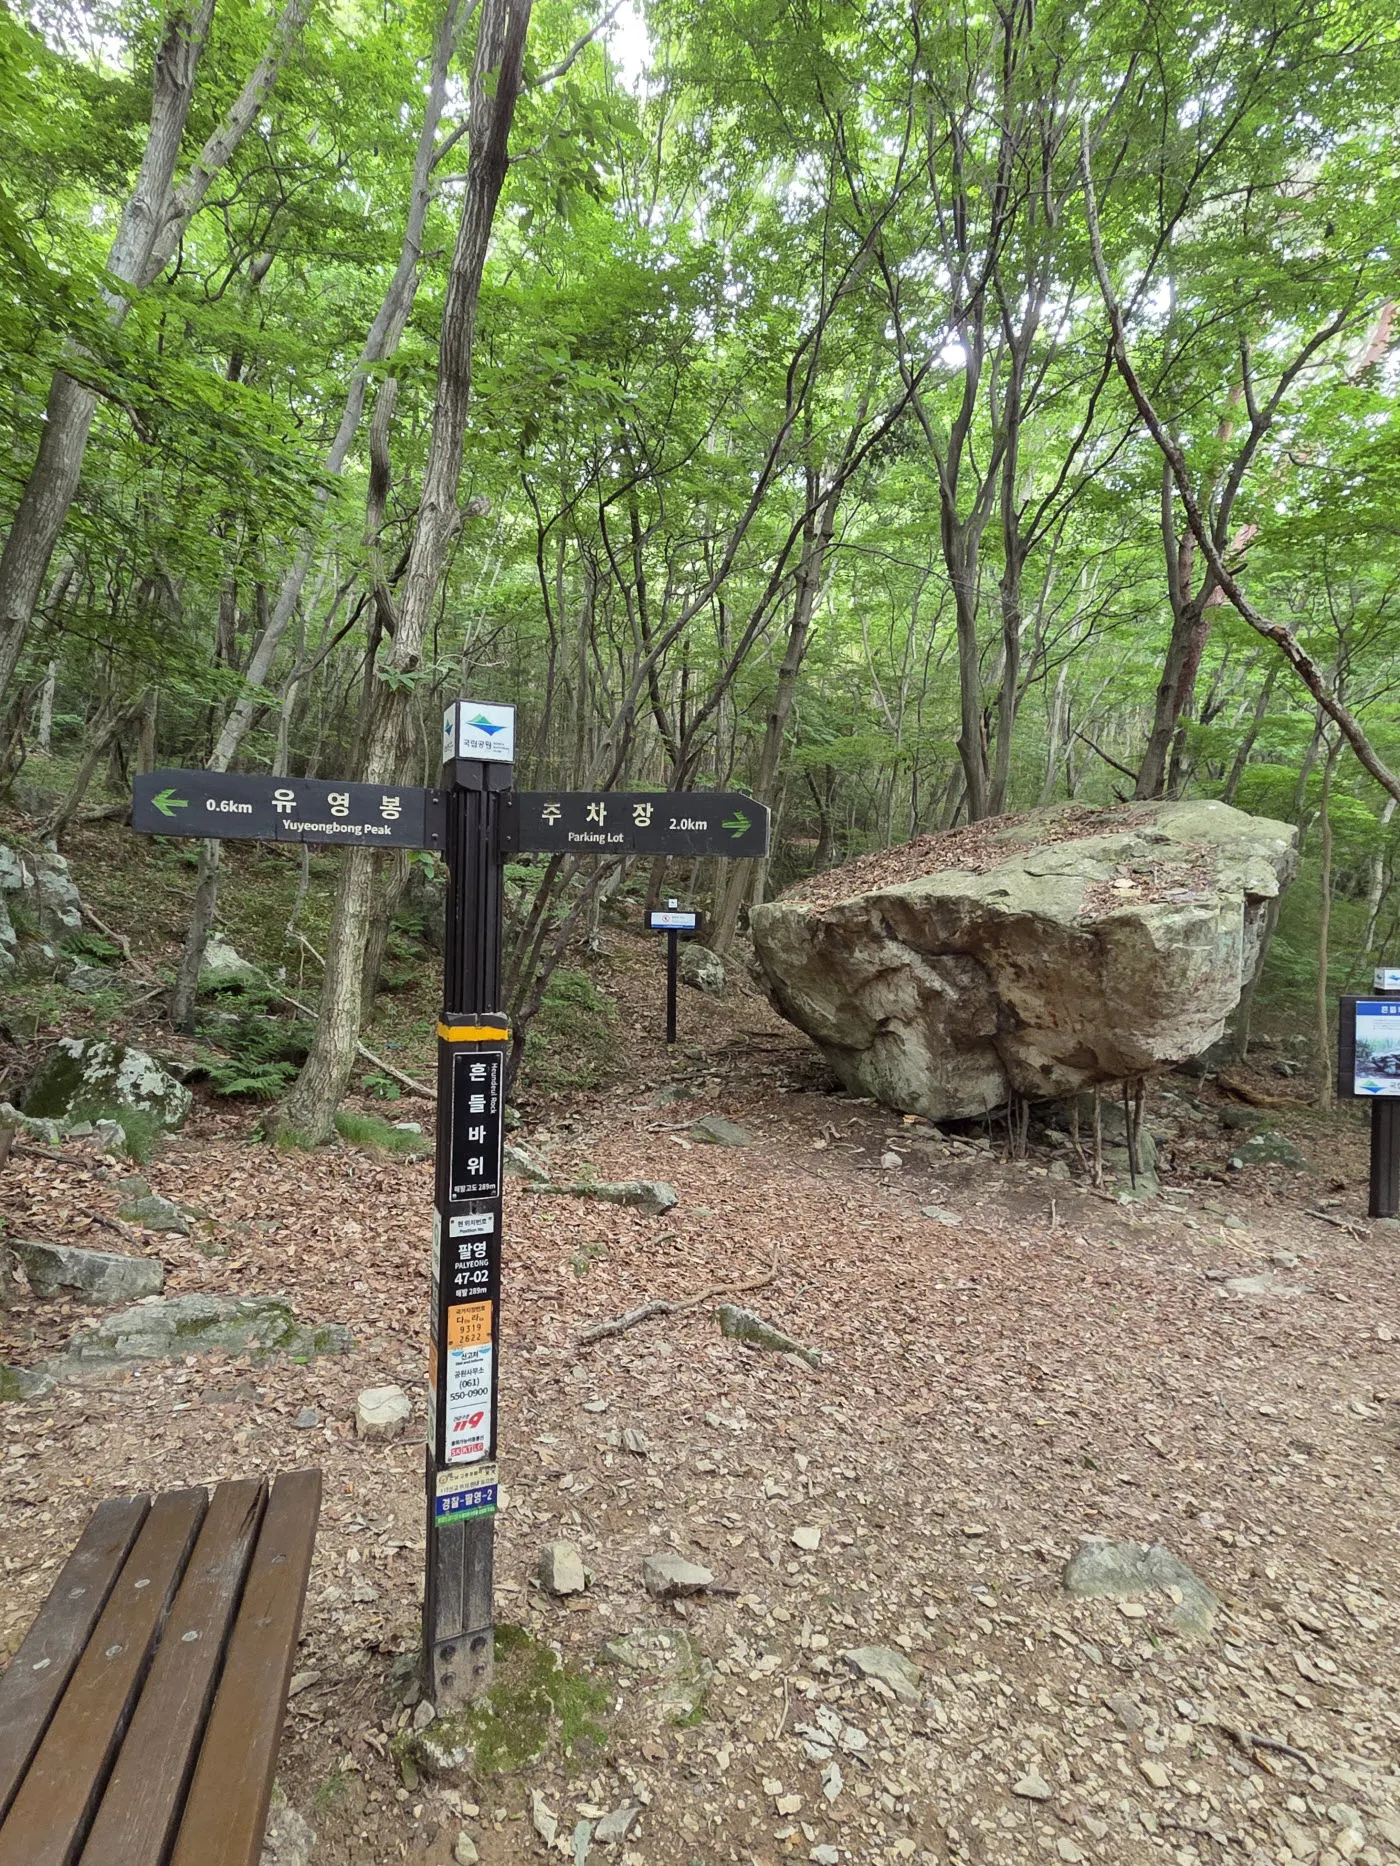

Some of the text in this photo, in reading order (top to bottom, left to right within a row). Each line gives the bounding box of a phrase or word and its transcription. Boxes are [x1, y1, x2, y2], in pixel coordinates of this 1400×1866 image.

[206, 799, 252, 813] 0.6km
[283, 819, 392, 836] Yuyeongbong Peak
[669, 818, 708, 830] 2.0km
[568, 832, 624, 844] Parking Lot
[490, 1063, 498, 1114] Heundeul Rock
[478, 1183, 496, 1191] 289m
[458, 1241, 487, 1260] 팔영
[454, 1259, 489, 1270] PALYEONG
[454, 1270, 489, 1285] 47-02
[454, 1367, 485, 1379] 공원사무소
[459, 1378, 480, 1390] (061)
[450, 1387, 489, 1401] 550-0900
[453, 1411, 484, 1432] 119
